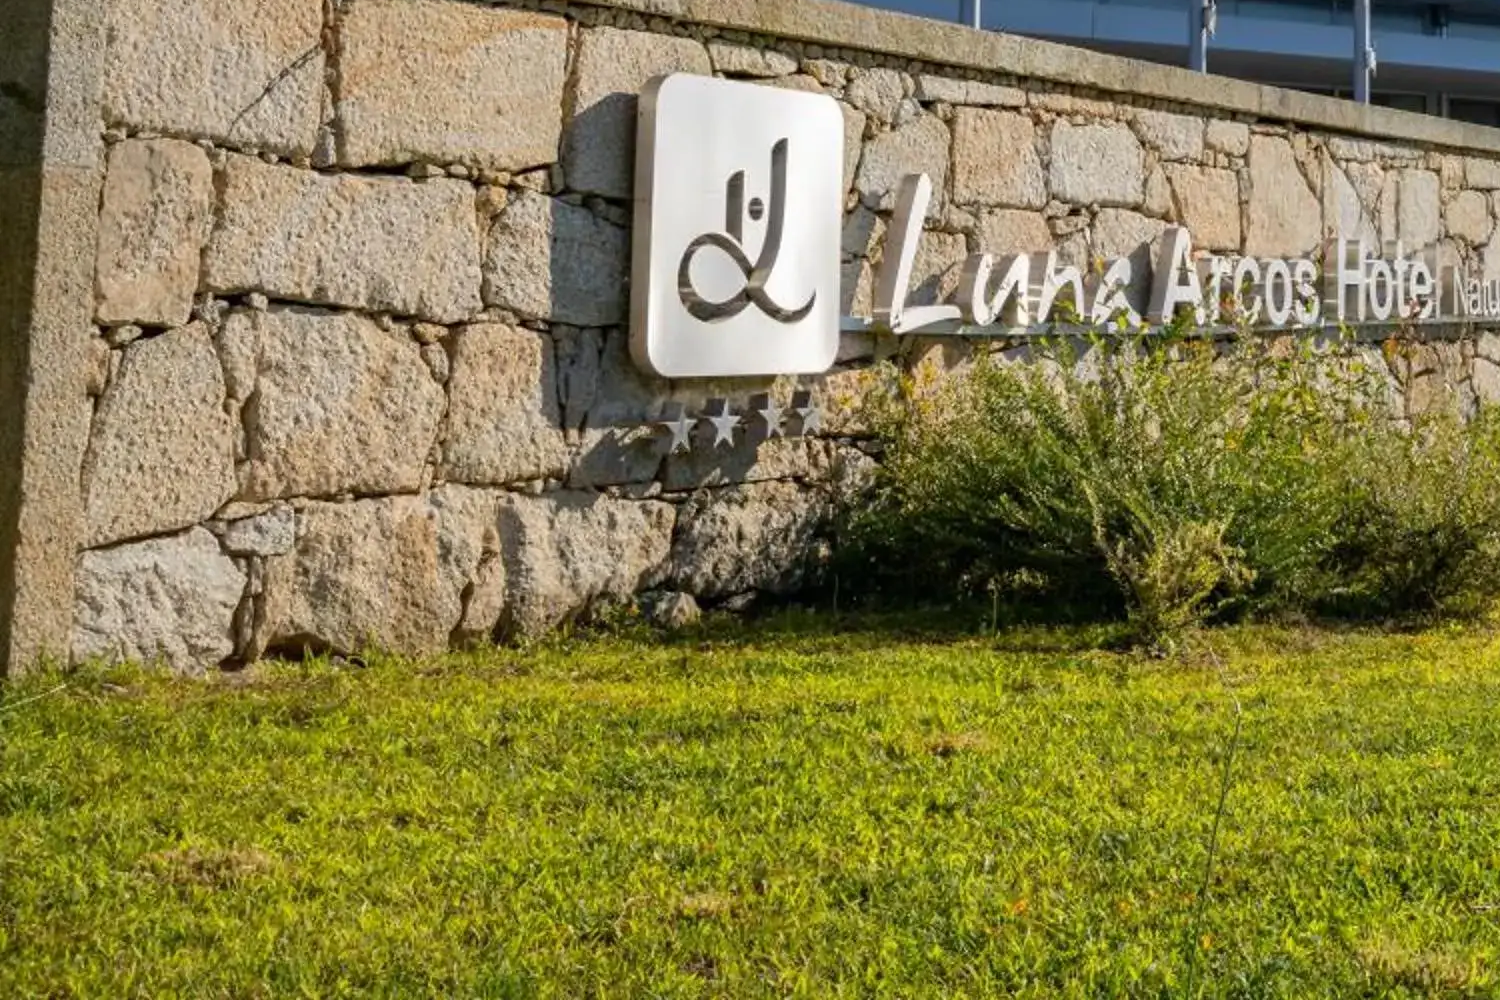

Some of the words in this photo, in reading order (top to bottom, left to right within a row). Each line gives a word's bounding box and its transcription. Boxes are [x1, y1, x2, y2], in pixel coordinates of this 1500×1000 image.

[890, 173, 1142, 333] Luna
[1162, 226, 1321, 326] Arcos
[1338, 238, 1441, 321] Hotel
